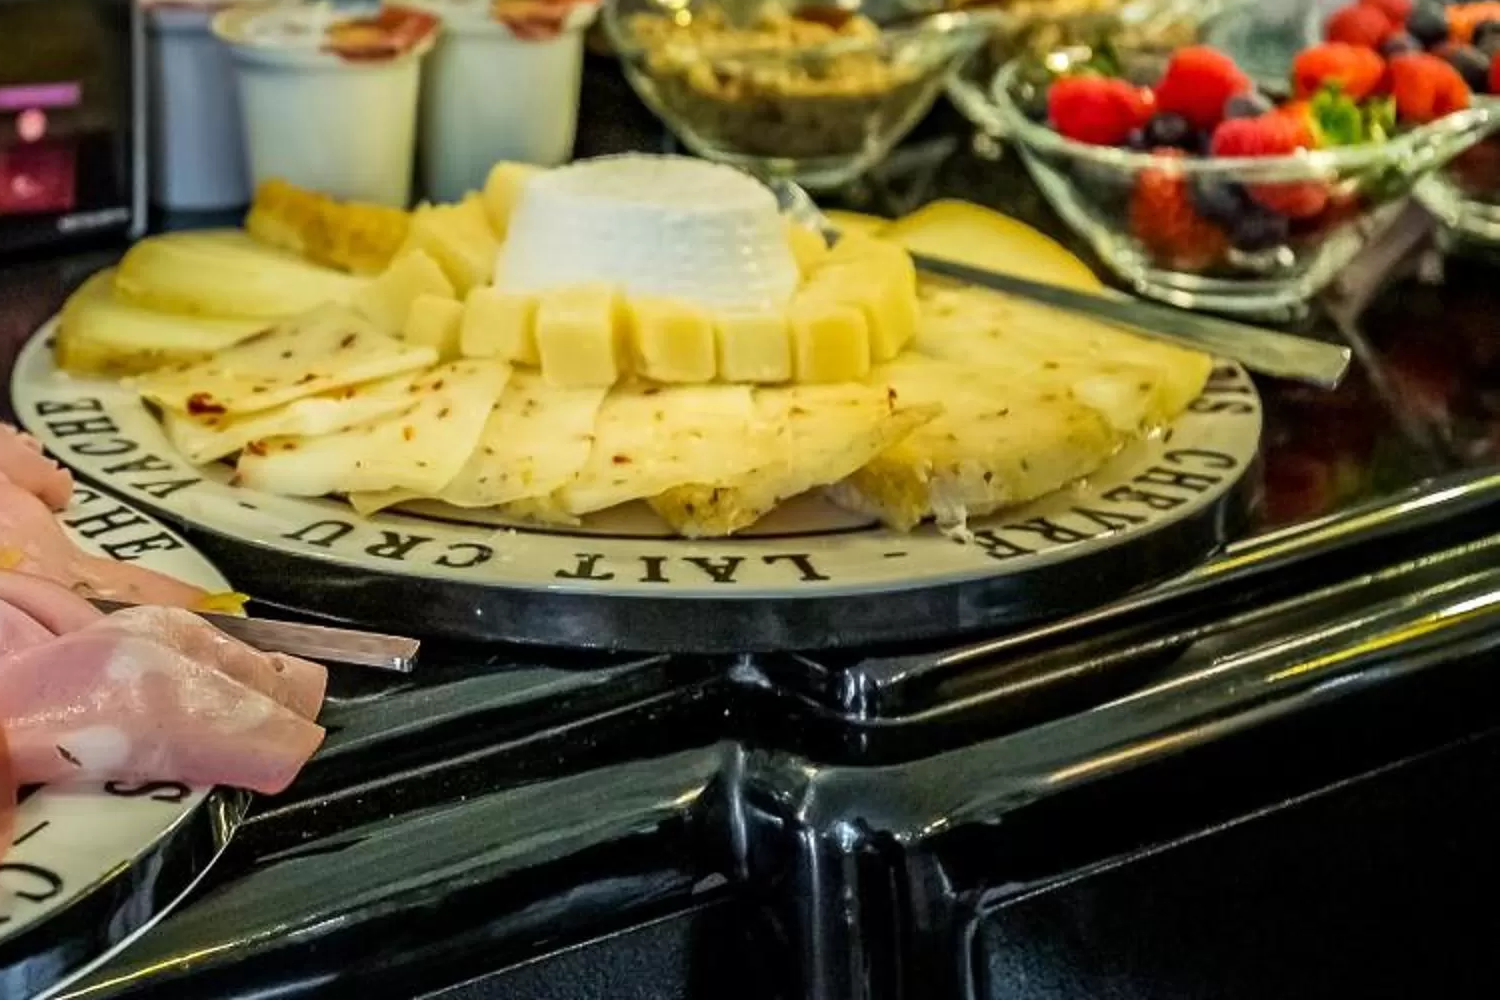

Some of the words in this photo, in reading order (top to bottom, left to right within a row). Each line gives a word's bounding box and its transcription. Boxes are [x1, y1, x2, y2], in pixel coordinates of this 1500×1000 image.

[34, 398, 204, 499] VACHE
[280, 519, 495, 569] CRU
[554, 553, 830, 583] LAIT
